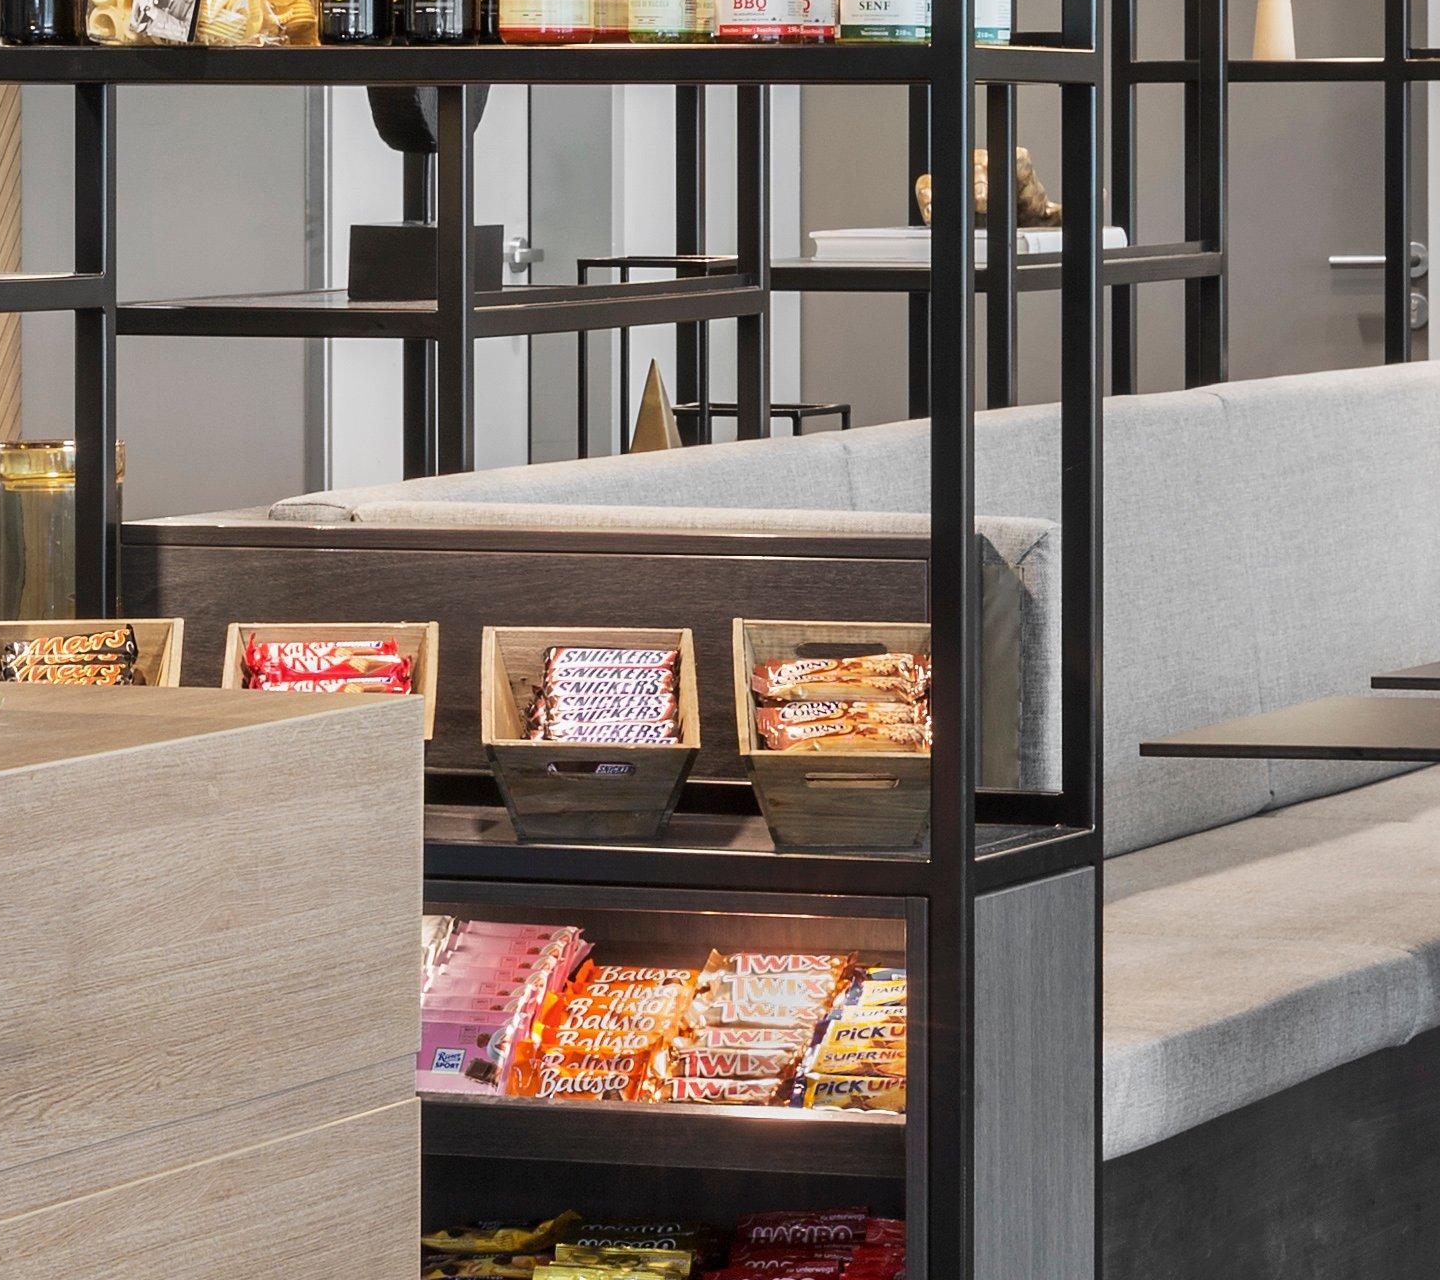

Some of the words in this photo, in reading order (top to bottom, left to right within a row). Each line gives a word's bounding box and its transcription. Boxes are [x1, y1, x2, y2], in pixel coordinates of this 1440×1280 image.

[859, 0, 891, 11] SENF
[19, 627, 129, 655] Mars
[560, 650, 665, 666] SNICKERS
[596, 966, 691, 984] Balisto
[731, 953, 831, 975] TWIX
[561, 1006, 655, 1031] Balisto
[435, 1062, 459, 1070] SPORT
[680, 1050, 783, 1078] TWIX
[536, 1069, 629, 1099] Balisto
